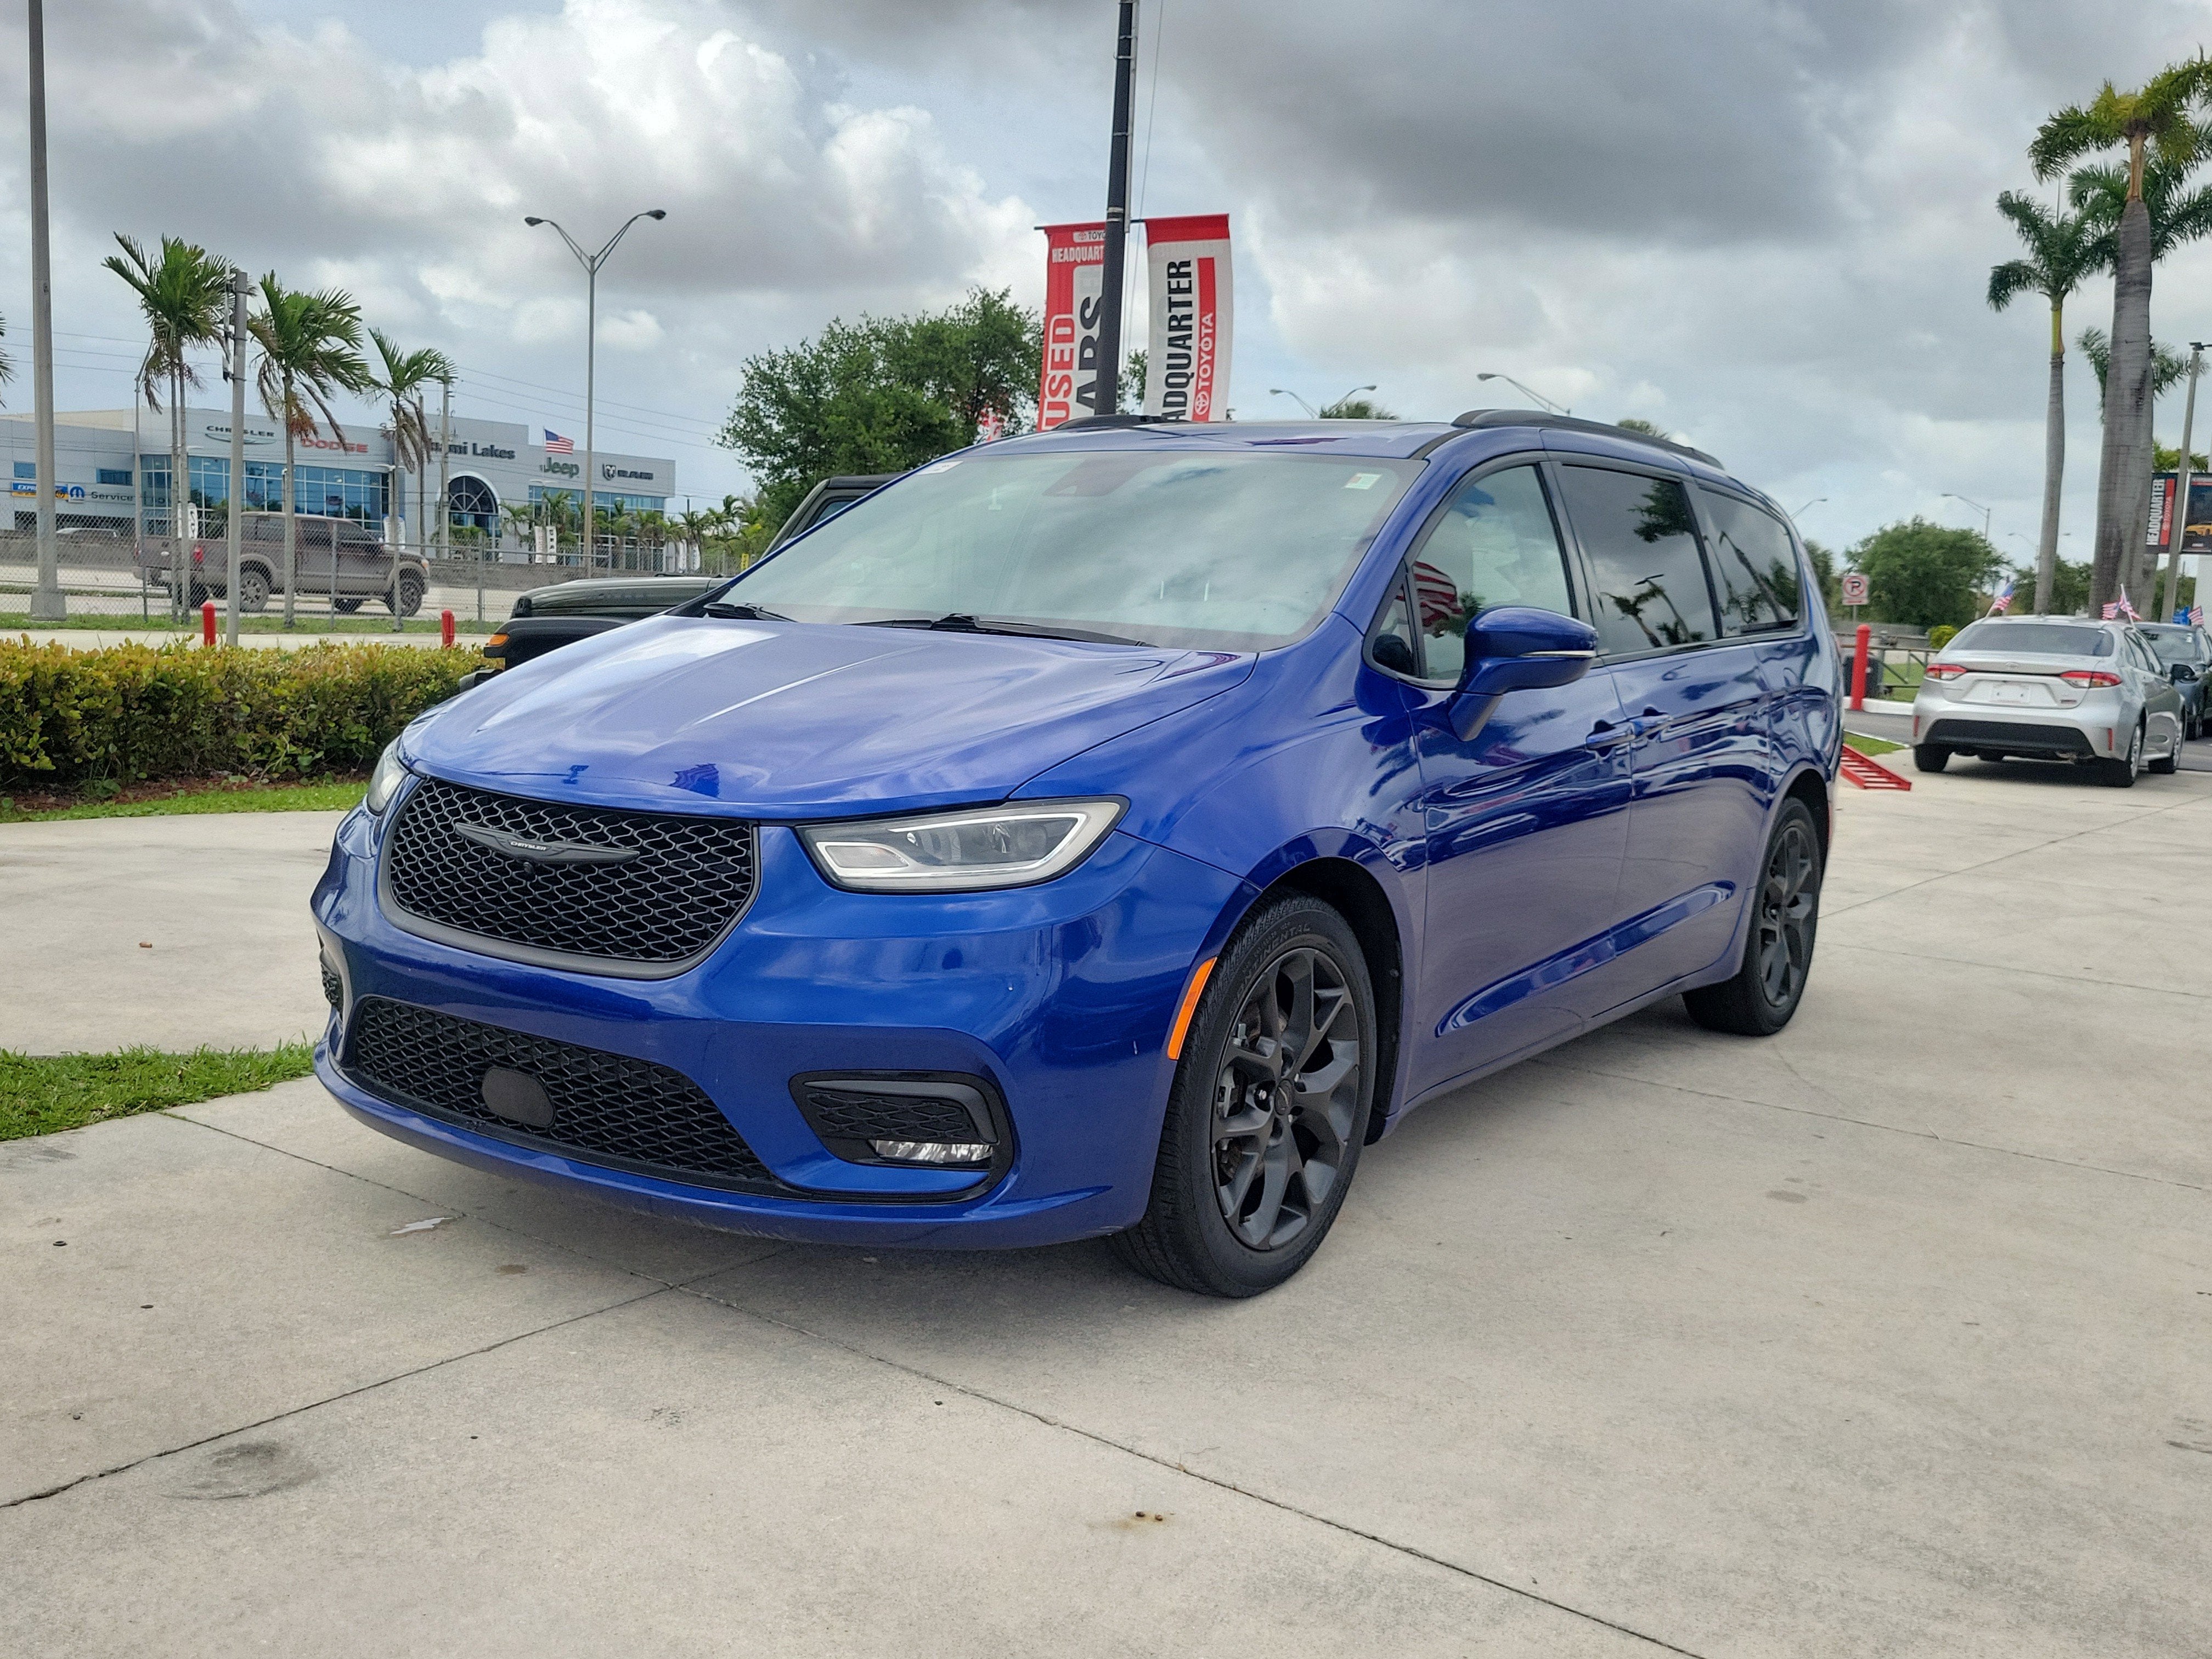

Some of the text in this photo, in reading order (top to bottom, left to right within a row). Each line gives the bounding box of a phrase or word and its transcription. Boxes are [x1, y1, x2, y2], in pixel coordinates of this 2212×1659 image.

[1052, 245, 1104, 263] HEADQUART
[1161, 260, 1194, 422] ADQUARTER
[1198, 312, 1214, 389] TOYOTA
[1044, 317, 1075, 430] USED
[206, 426, 274, 437] CHRSLER
[302, 438, 369, 453] DODGE
[472, 443, 516, 460] Lakes
[543, 457, 579, 478] Jeep
[91, 491, 134, 501] Service
[2146, 478, 2165, 546] HEADQUARTER
[510, 841, 547, 851] CHRYSLER
